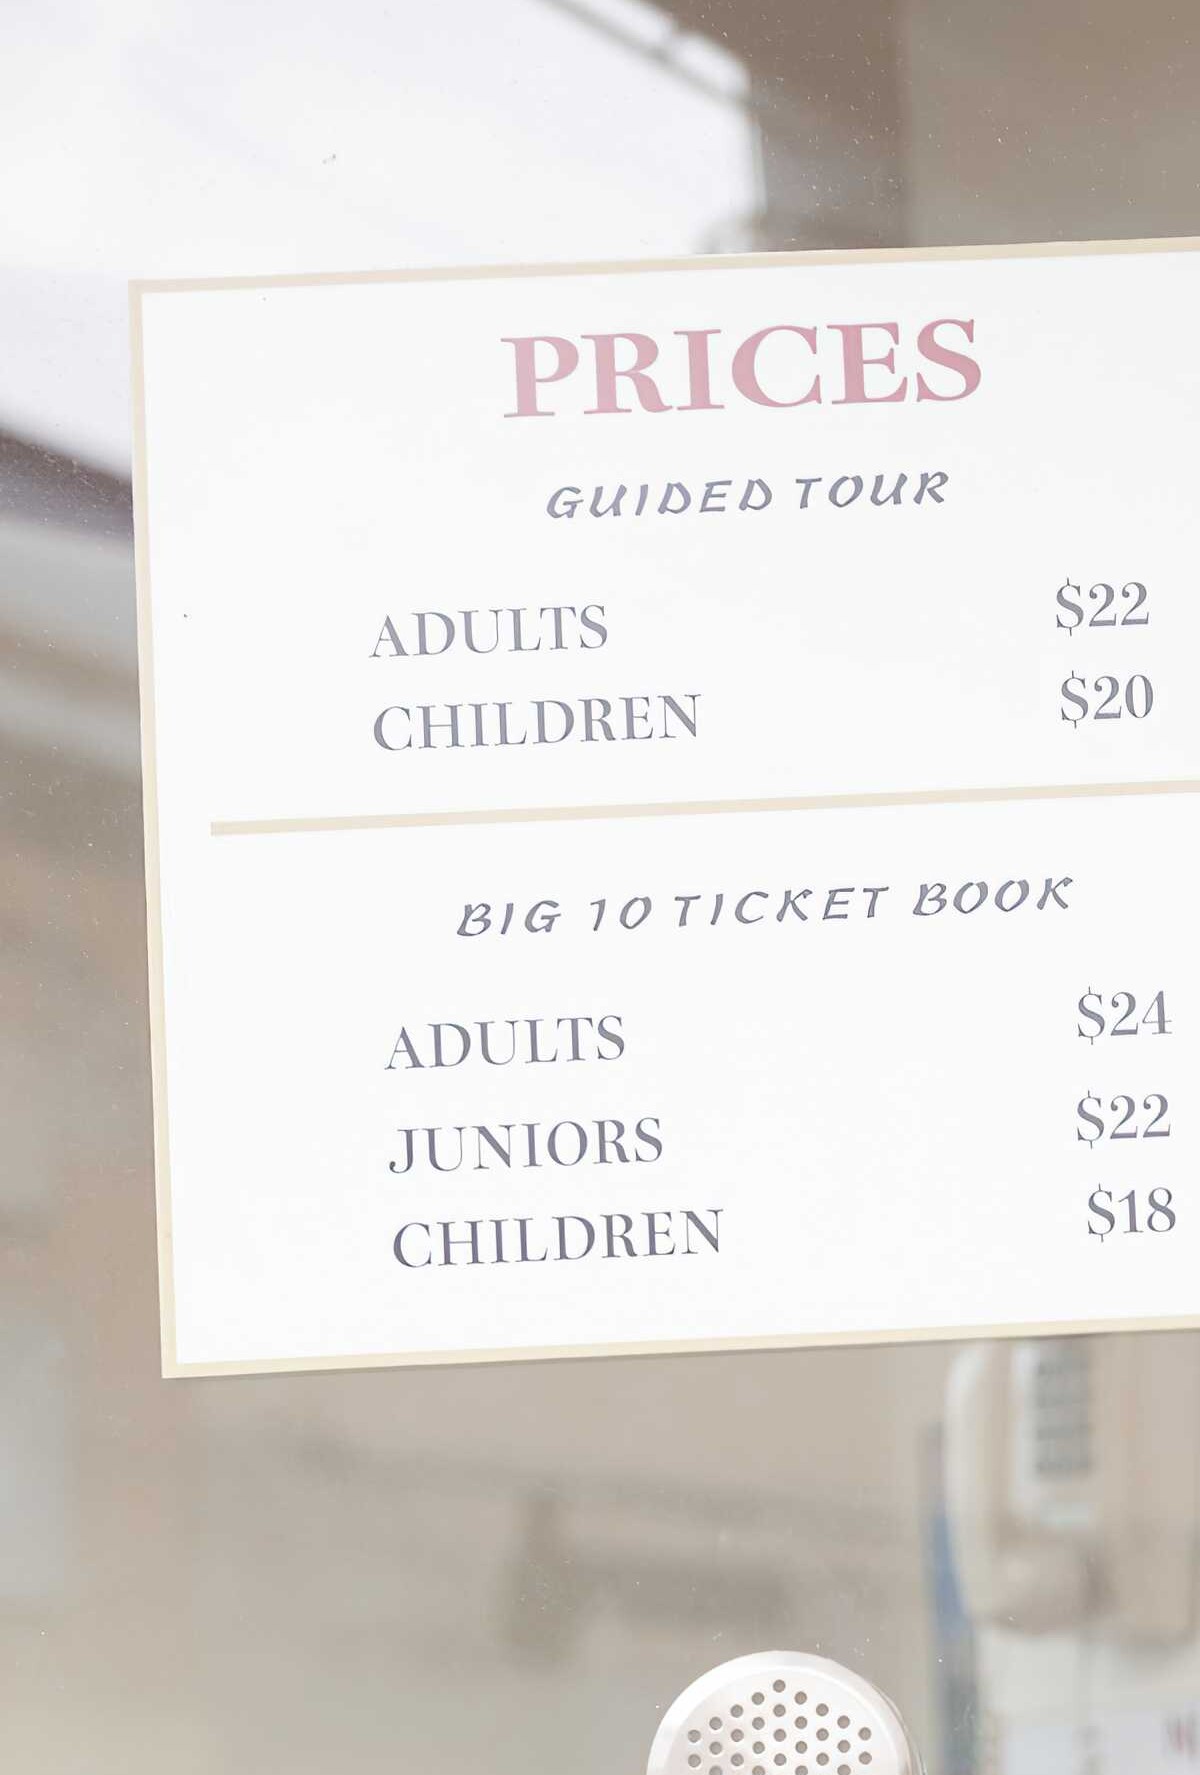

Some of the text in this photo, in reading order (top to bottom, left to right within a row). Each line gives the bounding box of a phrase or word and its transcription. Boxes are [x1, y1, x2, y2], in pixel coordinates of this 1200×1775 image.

[501, 319, 981, 417] PRICES
[547, 472, 949, 518] GUIDED TOUR
[369, 577, 1149, 657] ADULTS $22
[374, 670, 1153, 751] CHILDREN $20
[457, 877, 1073, 936] BIG 10 TICKET BOOK
[384, 986, 1172, 1070] ADULTS $24
[389, 1090, 1170, 1174] JUNIORS $22
[393, 1183, 1176, 1268] CHILDREN $18
